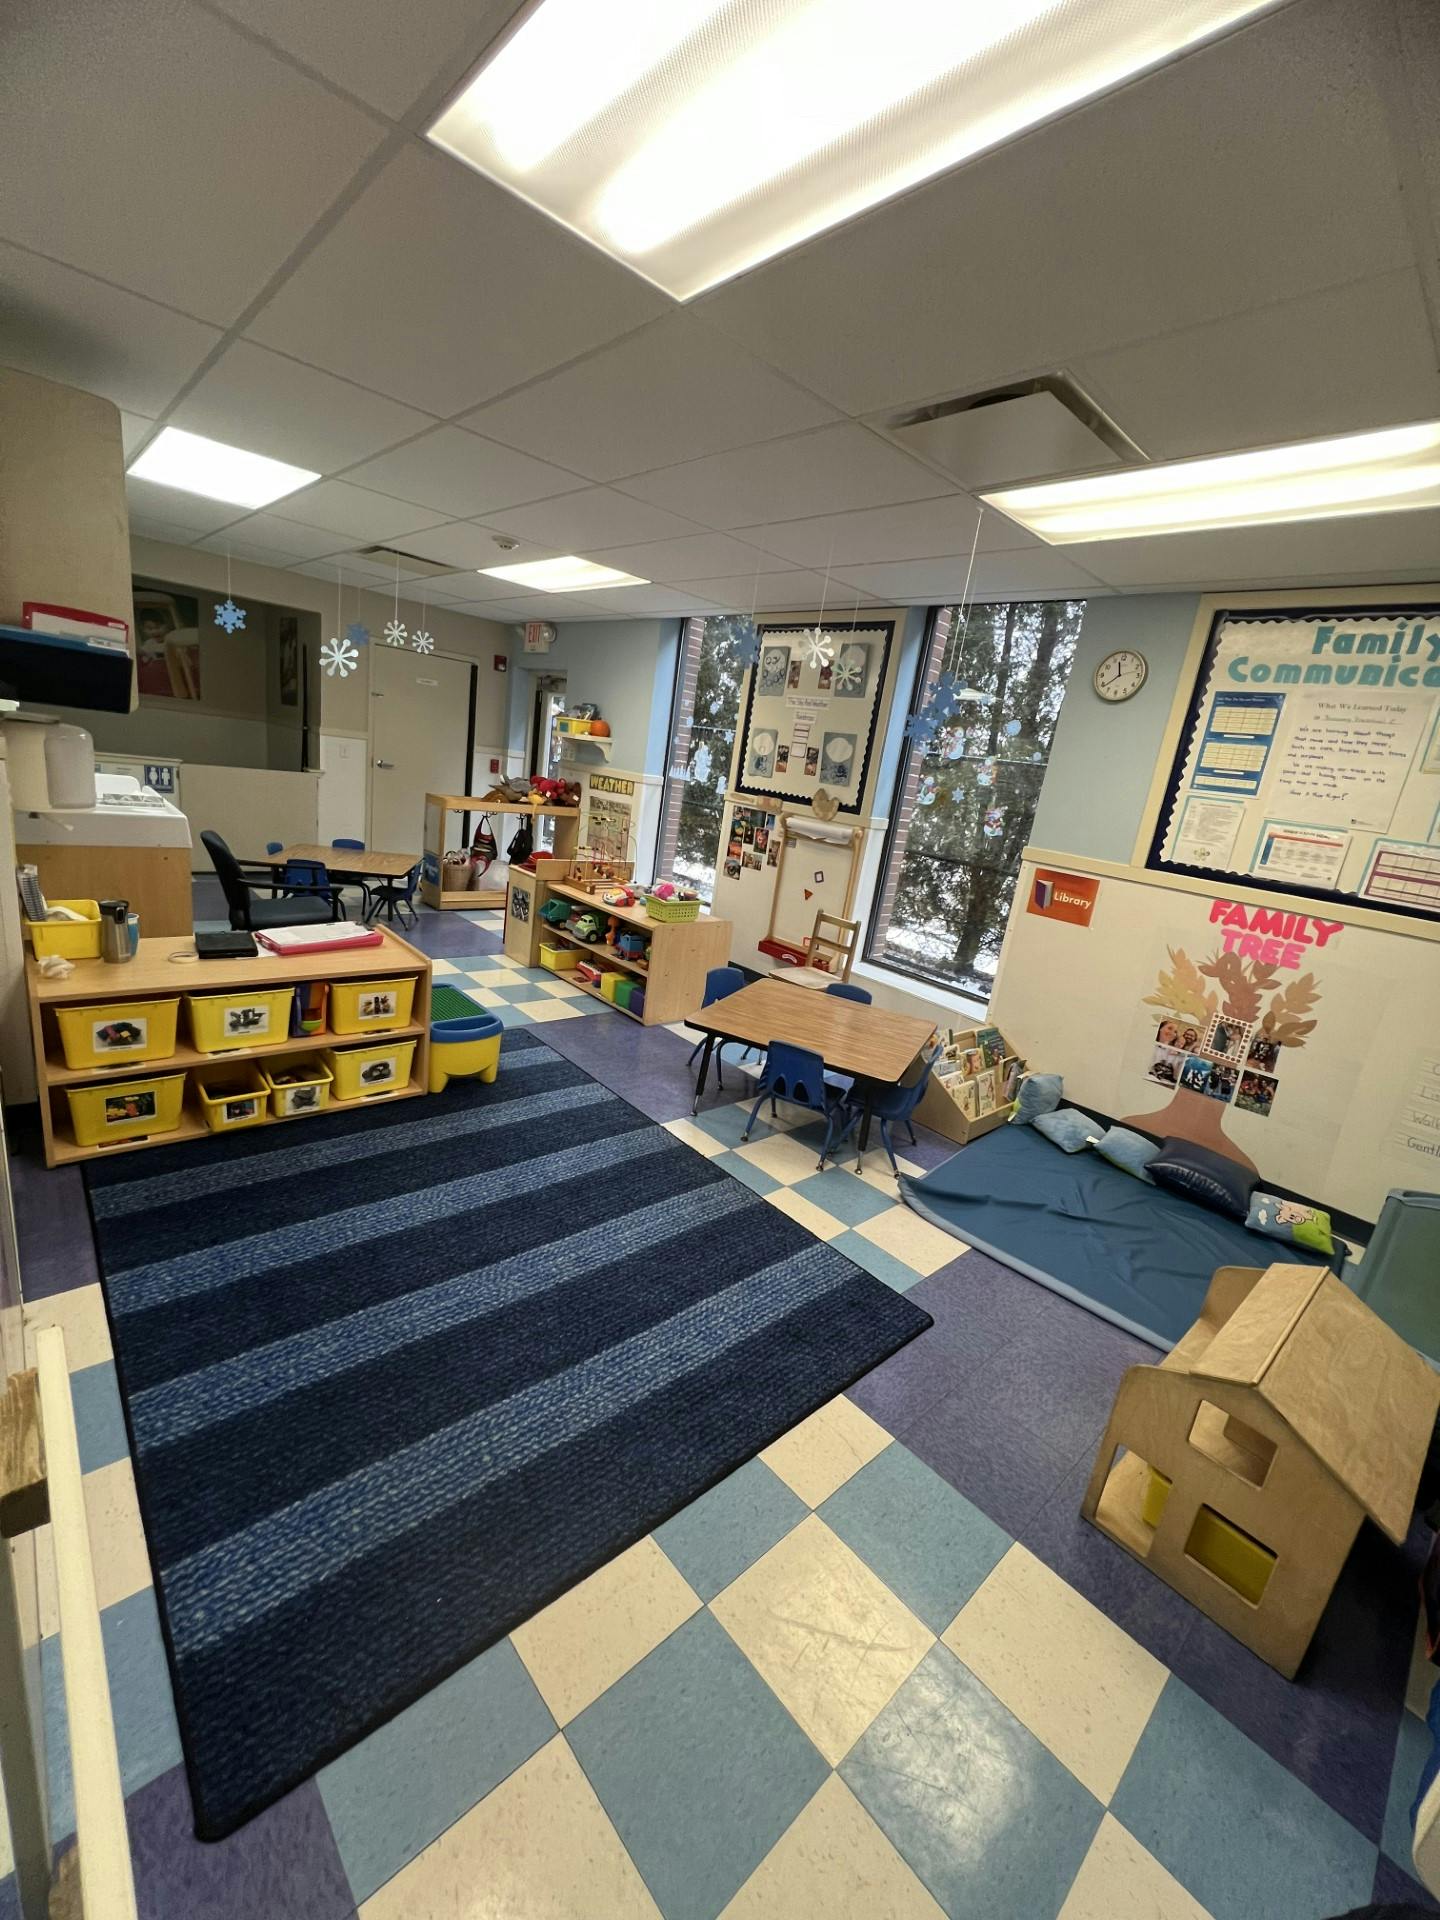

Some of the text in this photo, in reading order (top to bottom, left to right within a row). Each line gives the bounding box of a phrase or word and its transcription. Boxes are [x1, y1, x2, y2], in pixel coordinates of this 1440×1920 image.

[529, 623, 542, 643] EXIT
[1353, 704, 1383, 712] Learned
[1385, 705, 1407, 714] Today
[590, 775, 633, 795] WEATHER
[1054, 891, 1092, 910] Library
[1209, 899, 1345, 947] FAMILY
[1221, 928, 1306, 970] TREE
[1408, 1136, 1440, 1158] Gentl
